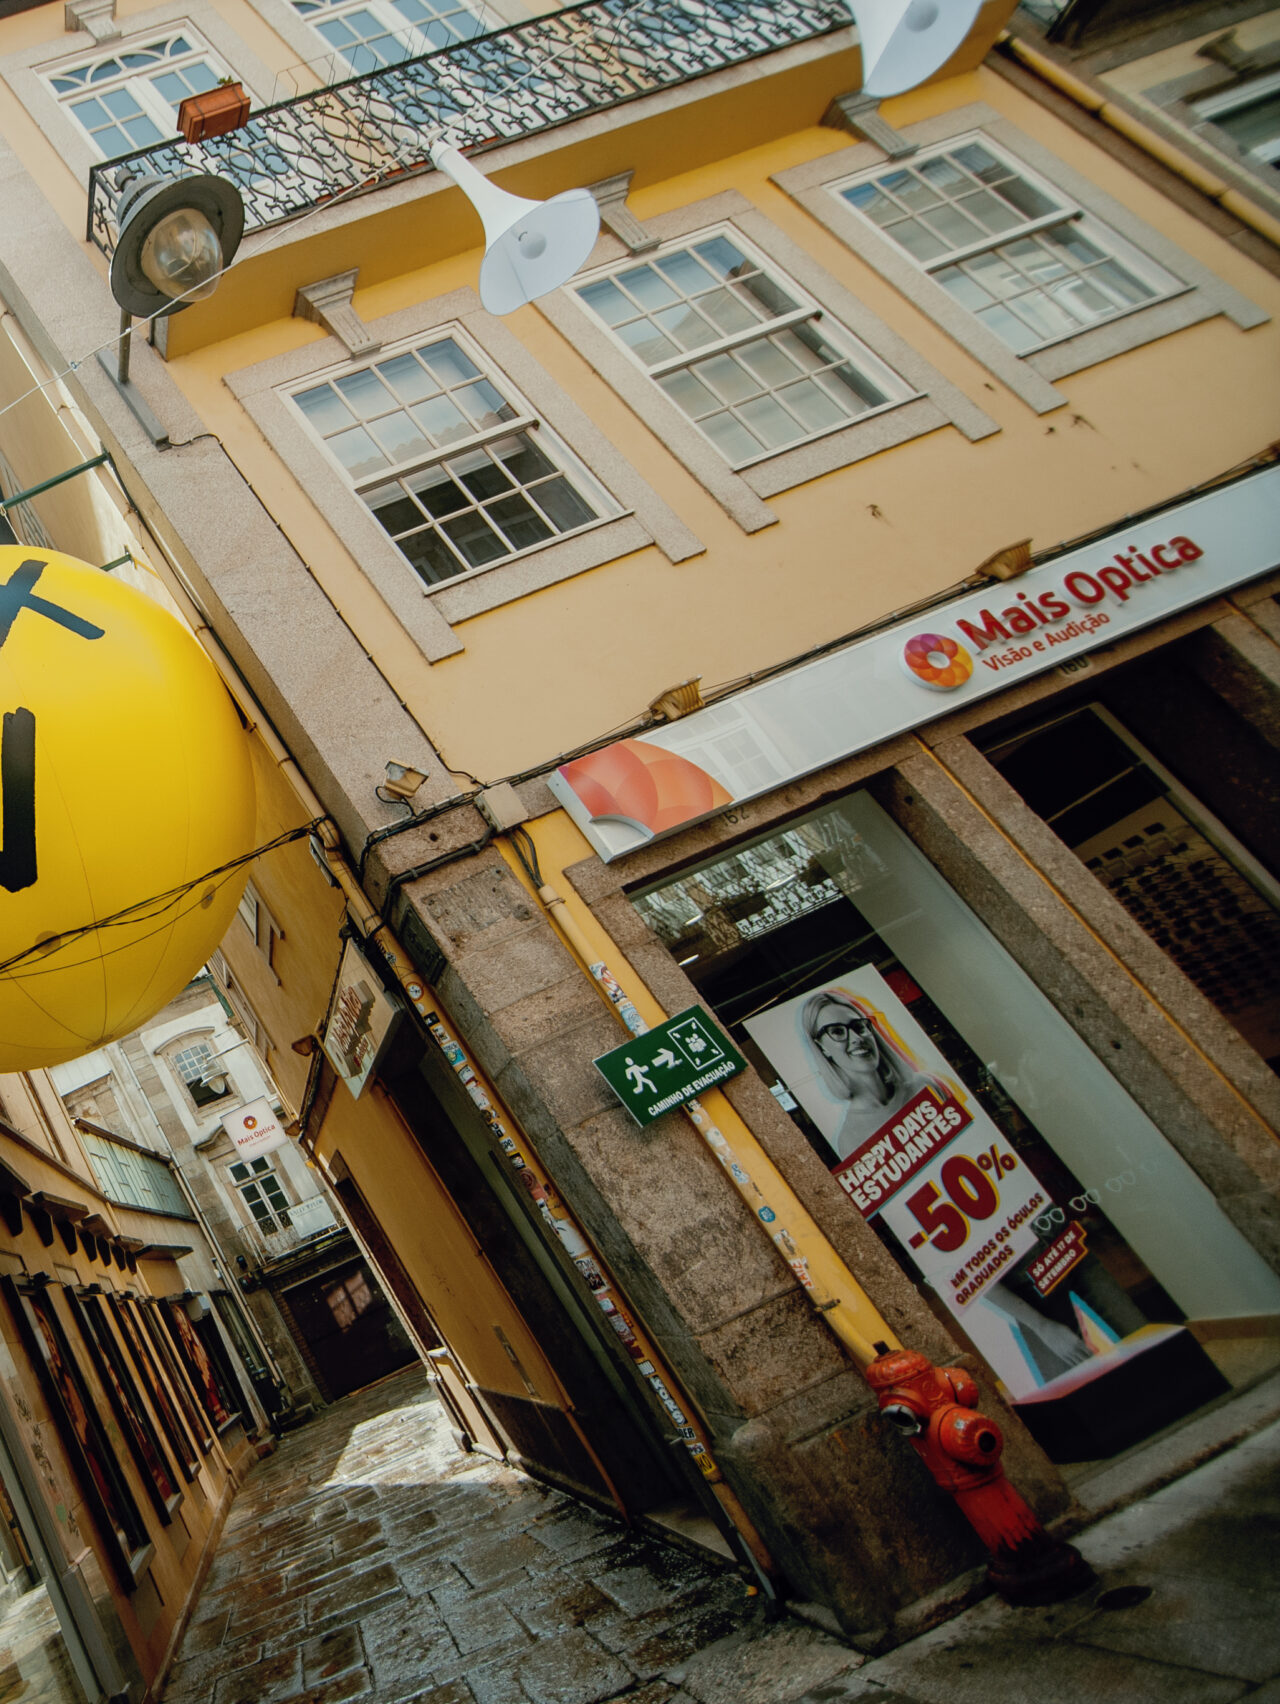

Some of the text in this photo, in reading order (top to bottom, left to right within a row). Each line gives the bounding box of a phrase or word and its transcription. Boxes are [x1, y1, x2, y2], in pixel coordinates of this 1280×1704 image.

[955, 535, 1204, 651] Mais Optica
[982, 612, 1111, 672] Visão e Audição
[647, 1060, 737, 1117] CAMINHO DE EVACUAÇÃO
[236, 1134, 255, 1147] Mais
[253, 1123, 277, 1143] Optica
[837, 1100, 939, 1194] HAPPY DAYS
[850, 1106, 963, 1212] ESTUDANTES
[907, 1143, 1019, 1253] -50%
[950, 1192, 1045, 1289] EM TODOS OS ÓCULOS
[1038, 1248, 1078, 1290] SETEMBRO
[1043, 1246, 1060, 1266] ATÉ
[1063, 1230, 1077, 1244] DE
[955, 1245, 1016, 1306] GRADUADOS
